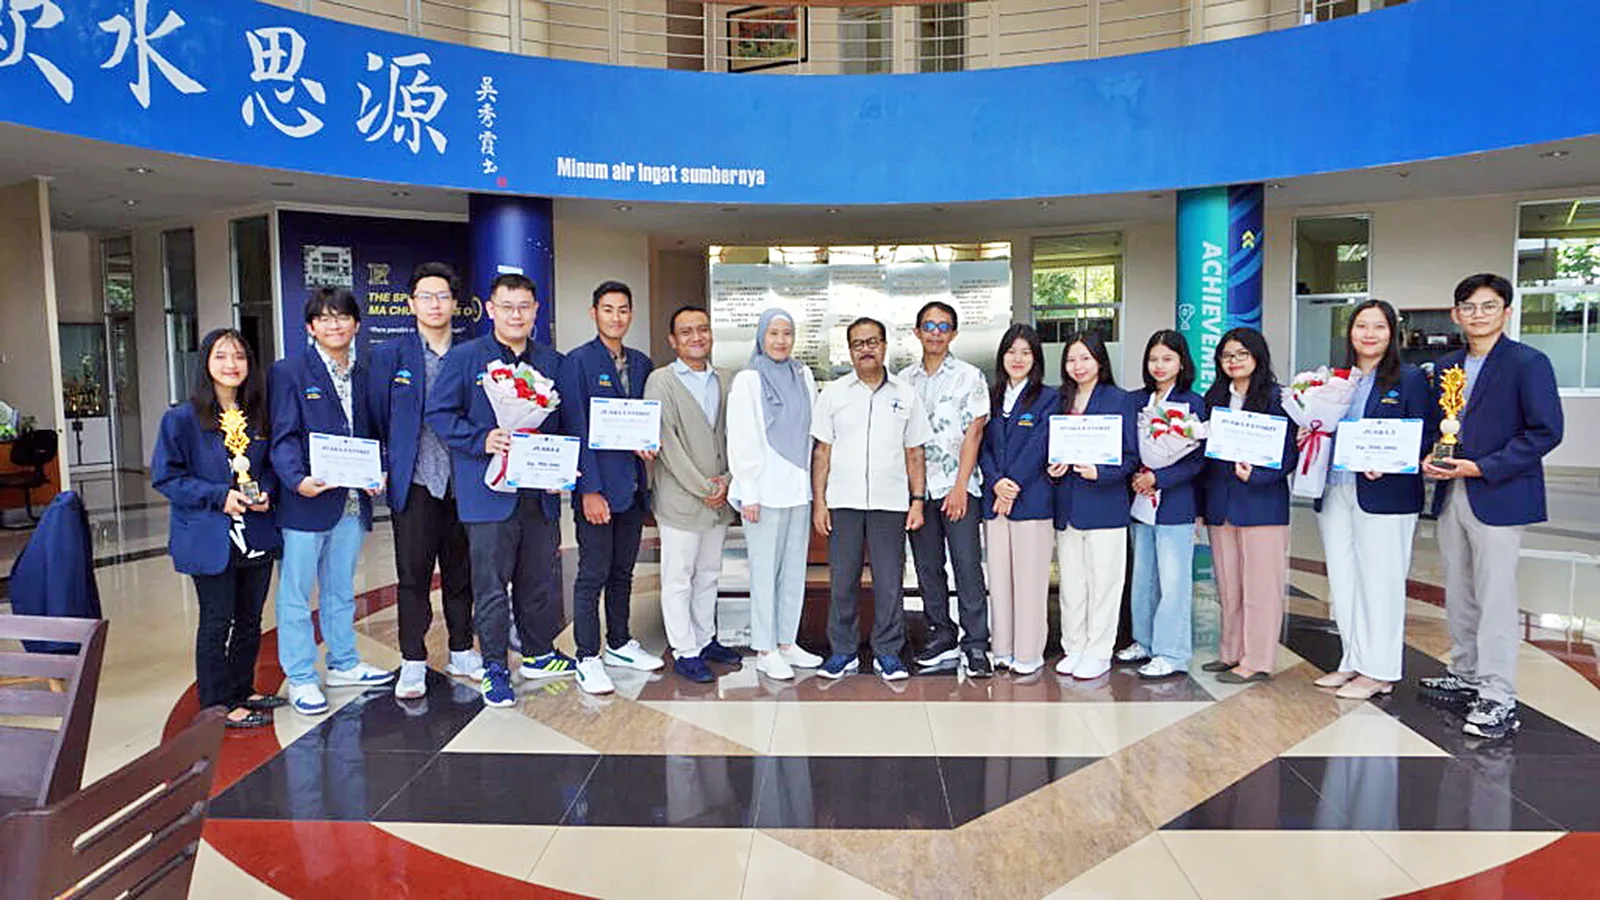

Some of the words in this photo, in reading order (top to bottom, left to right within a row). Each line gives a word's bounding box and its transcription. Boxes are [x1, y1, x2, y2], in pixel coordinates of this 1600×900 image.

[557, 156, 608, 179] Minum
[612, 161, 635, 181] air
[638, 162, 677, 185] ingat
[680, 165, 765, 187] sumbernya
[369, 293, 391, 302] THE
[368, 305, 387, 315] MA
[389, 305, 415, 315] CHU
[1201, 240, 1223, 398] ACHIEVEME
